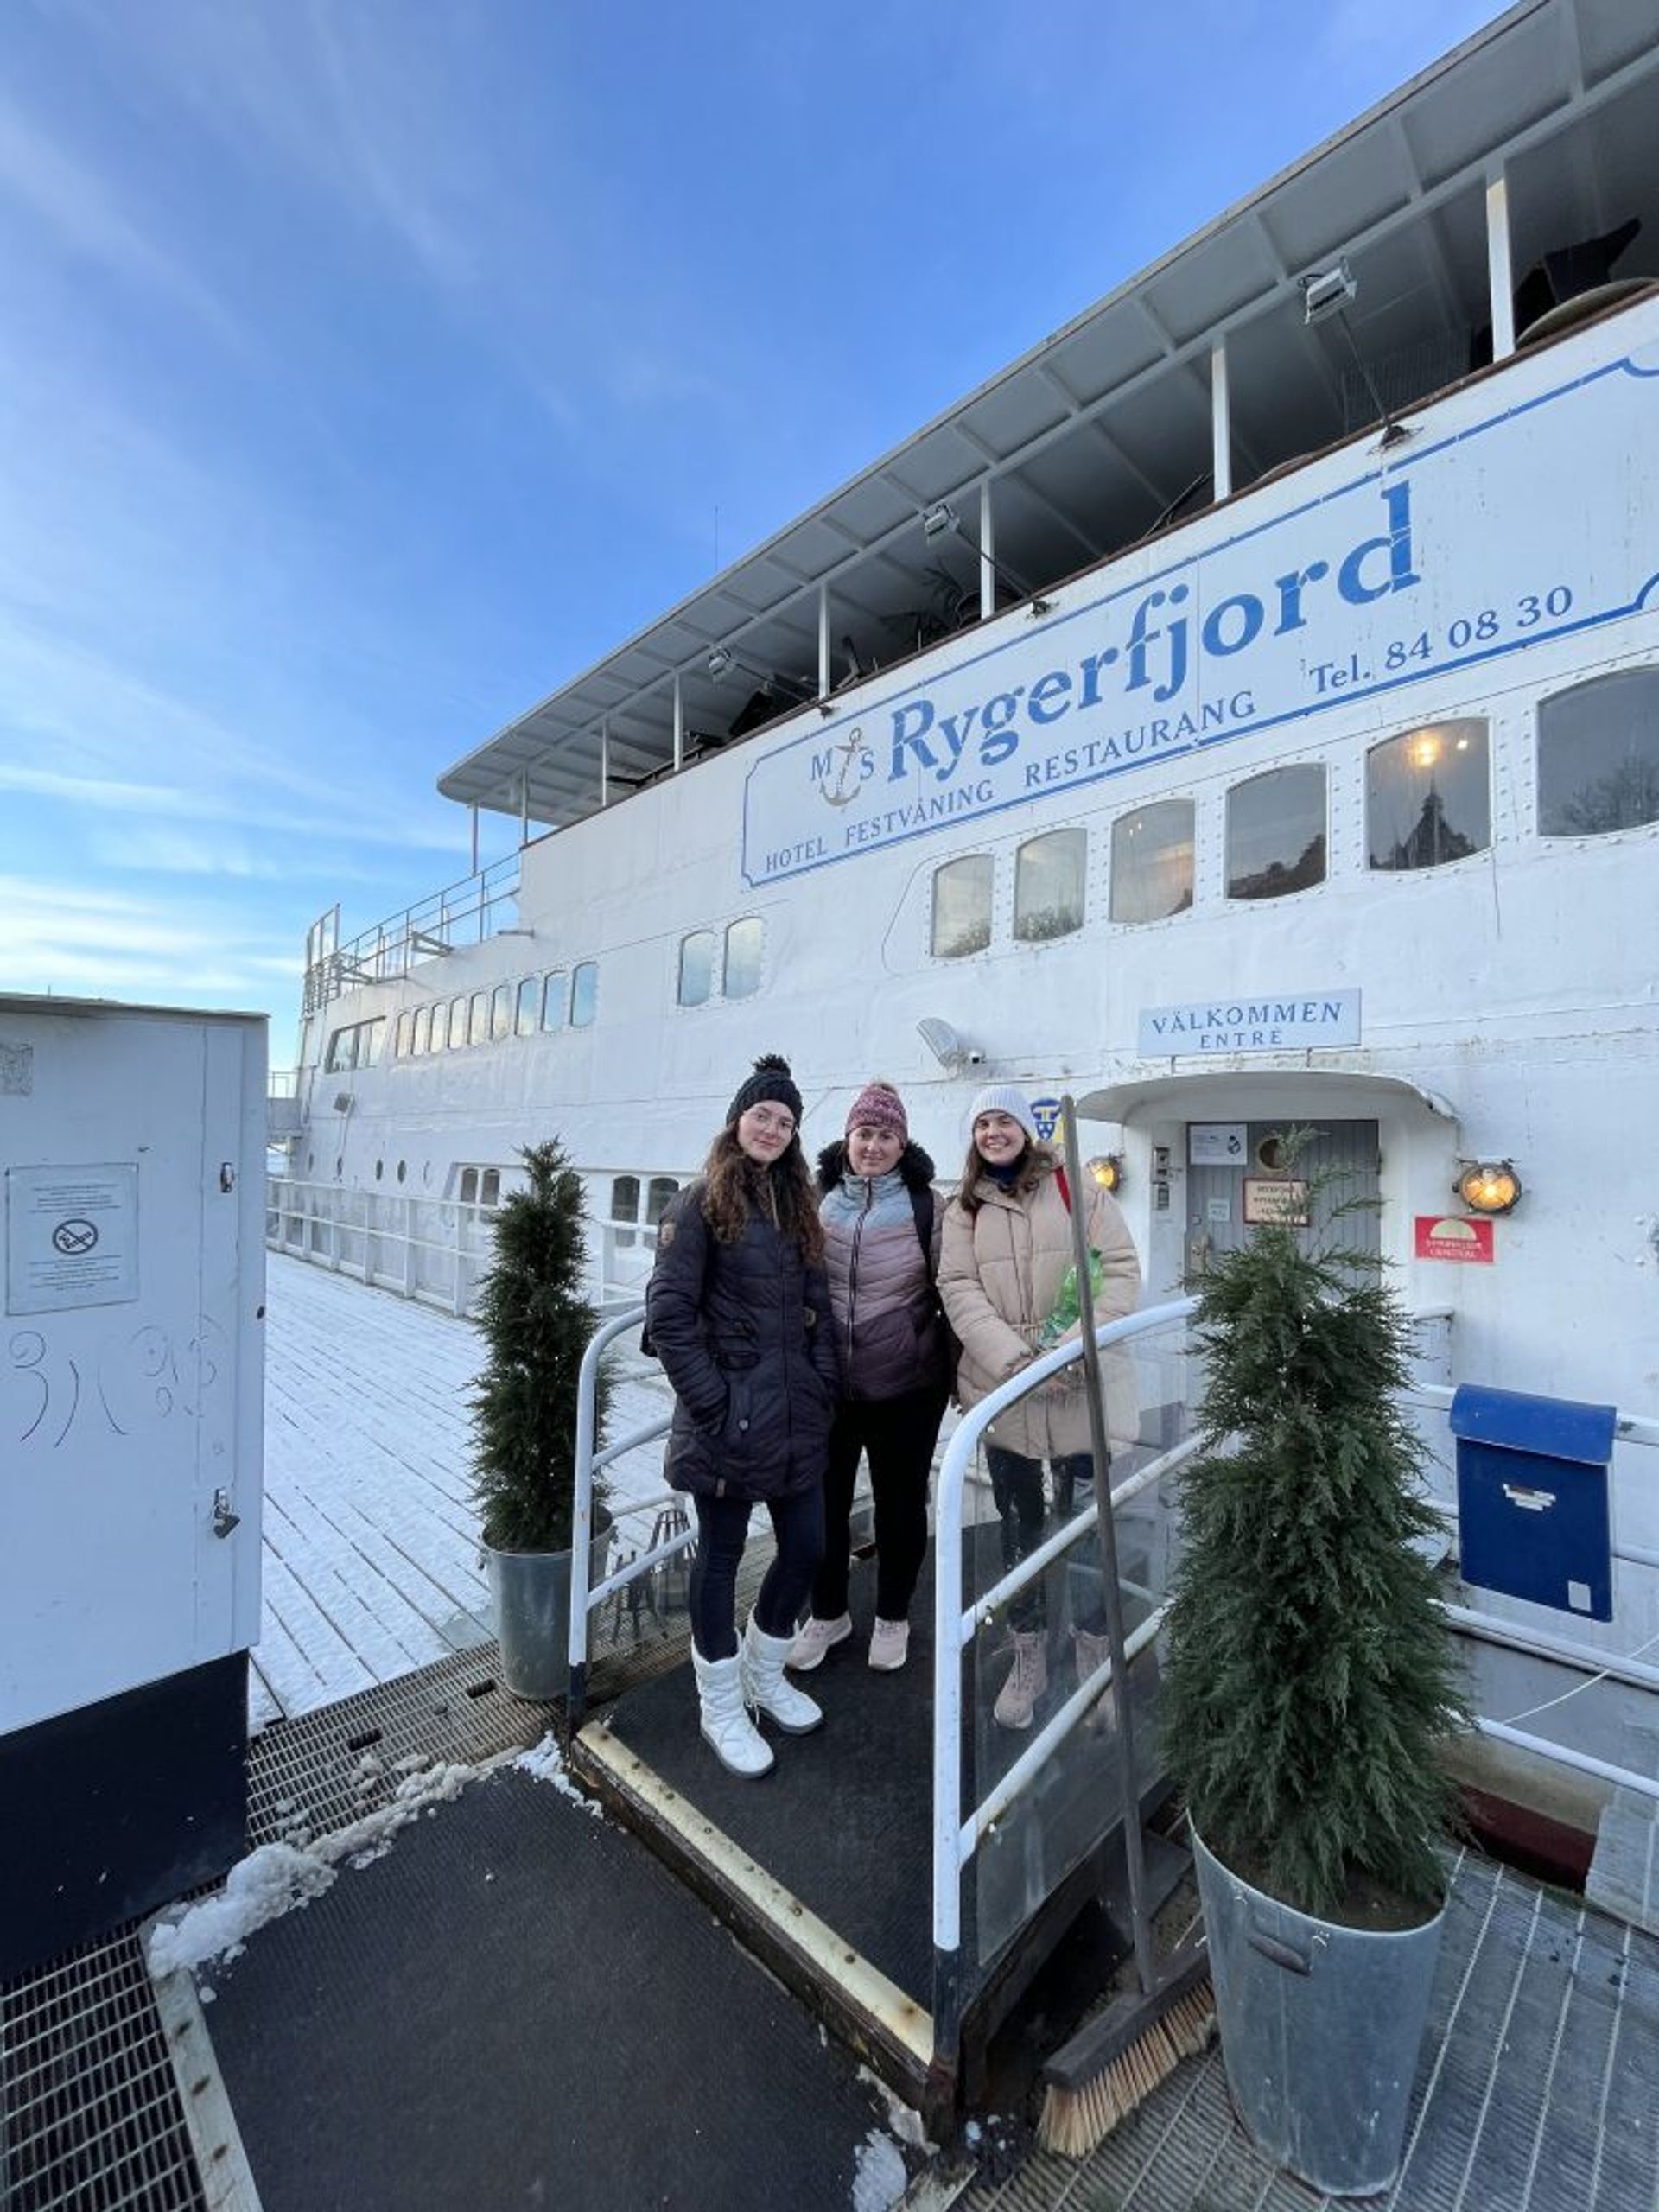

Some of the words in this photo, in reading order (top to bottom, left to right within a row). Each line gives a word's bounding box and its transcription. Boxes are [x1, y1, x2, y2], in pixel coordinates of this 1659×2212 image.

[810, 747, 832, 781] M
[859, 750, 874, 781] S
[887, 479, 1421, 783] Rygerfjord
[1309, 652, 1372, 693] Tel.
[1384, 631, 1433, 670] 84
[1448, 610, 1500, 650] 08
[1516, 585, 1573, 628] 30
[766, 836, 828, 874] HOTEL
[845, 779, 995, 848] FESTVÅNING
[1025, 690, 1256, 788] RESTAURANG
[1152, 1001, 1343, 1035] VÄLKOMMEN
